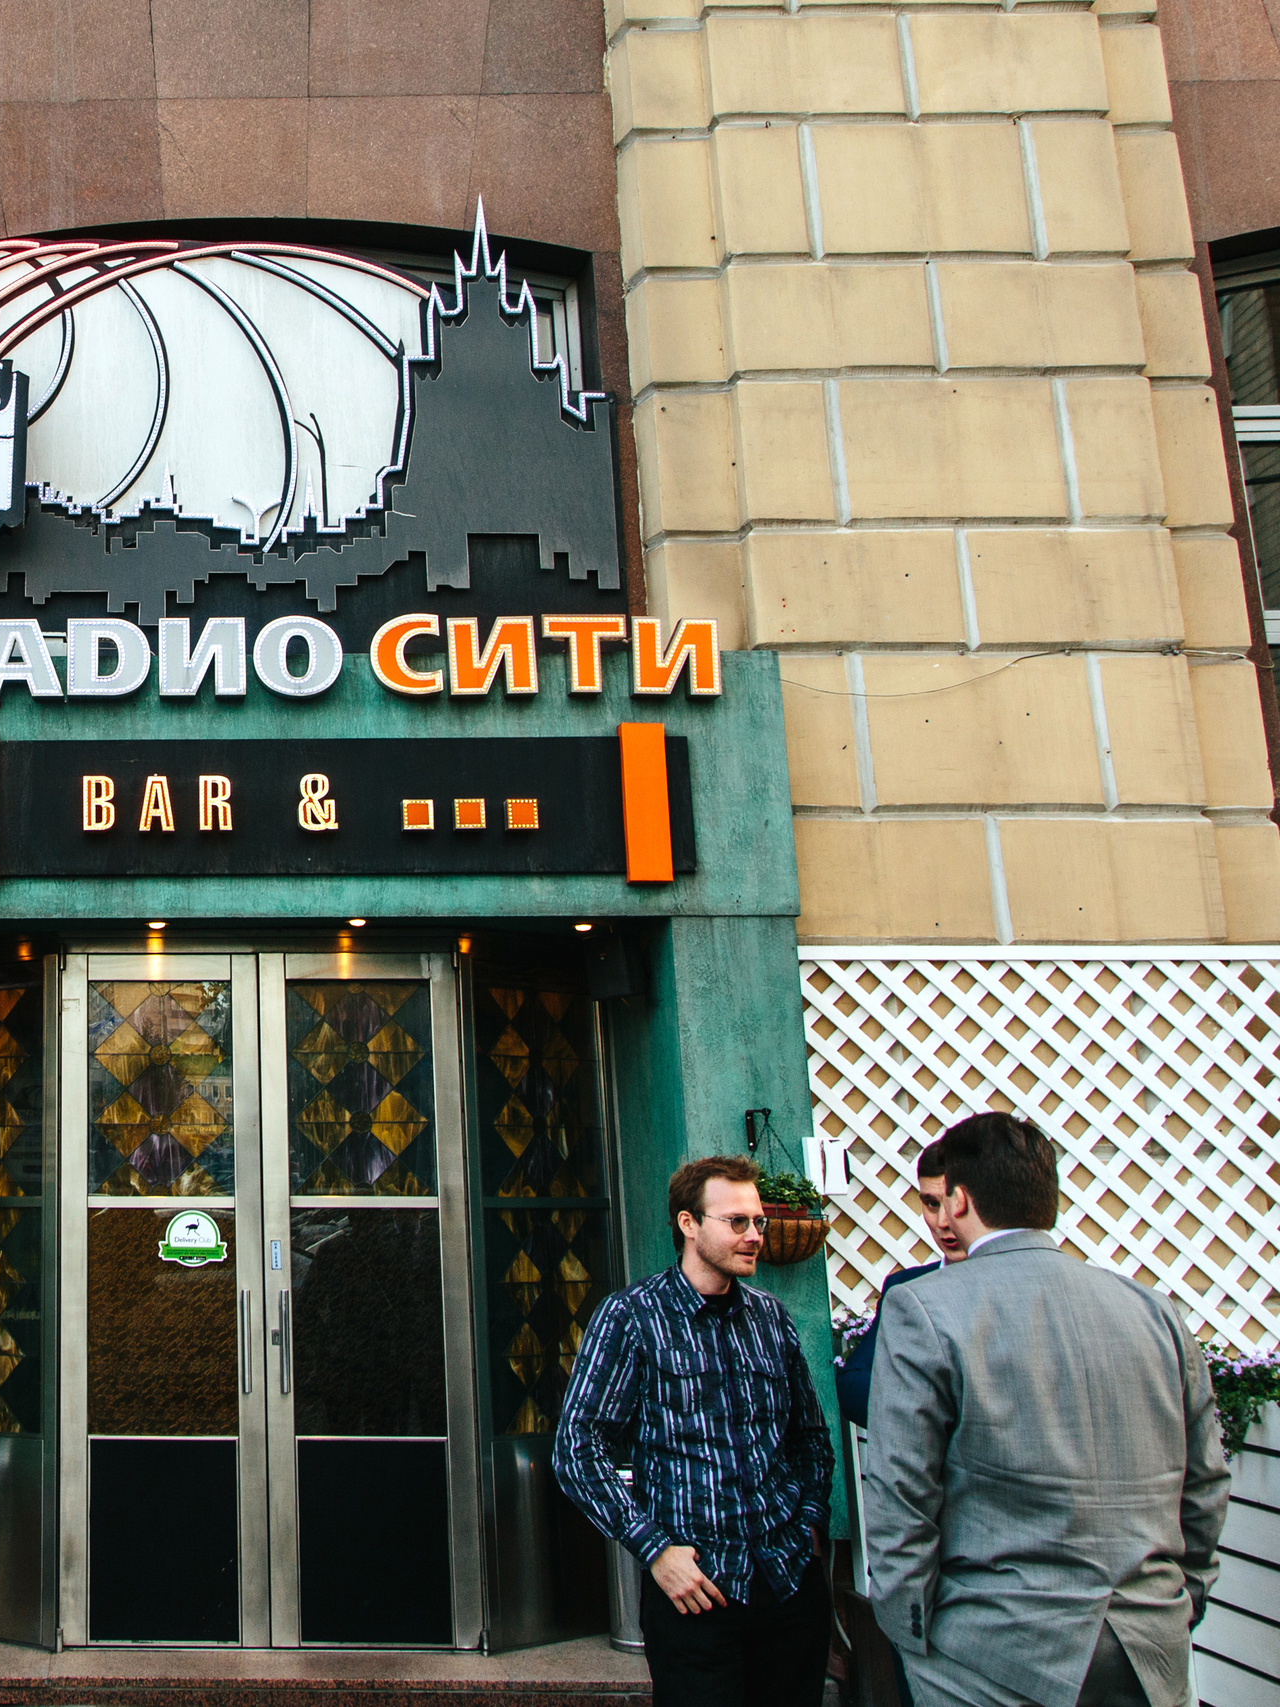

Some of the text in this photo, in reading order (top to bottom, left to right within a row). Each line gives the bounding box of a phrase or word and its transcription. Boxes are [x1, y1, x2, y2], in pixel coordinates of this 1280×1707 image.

[370, 613, 722, 699] СИТИ
[81, 773, 234, 832] BAR
[297, 773, 339, 831] &
[174, 1236, 197, 1244] Delivery
